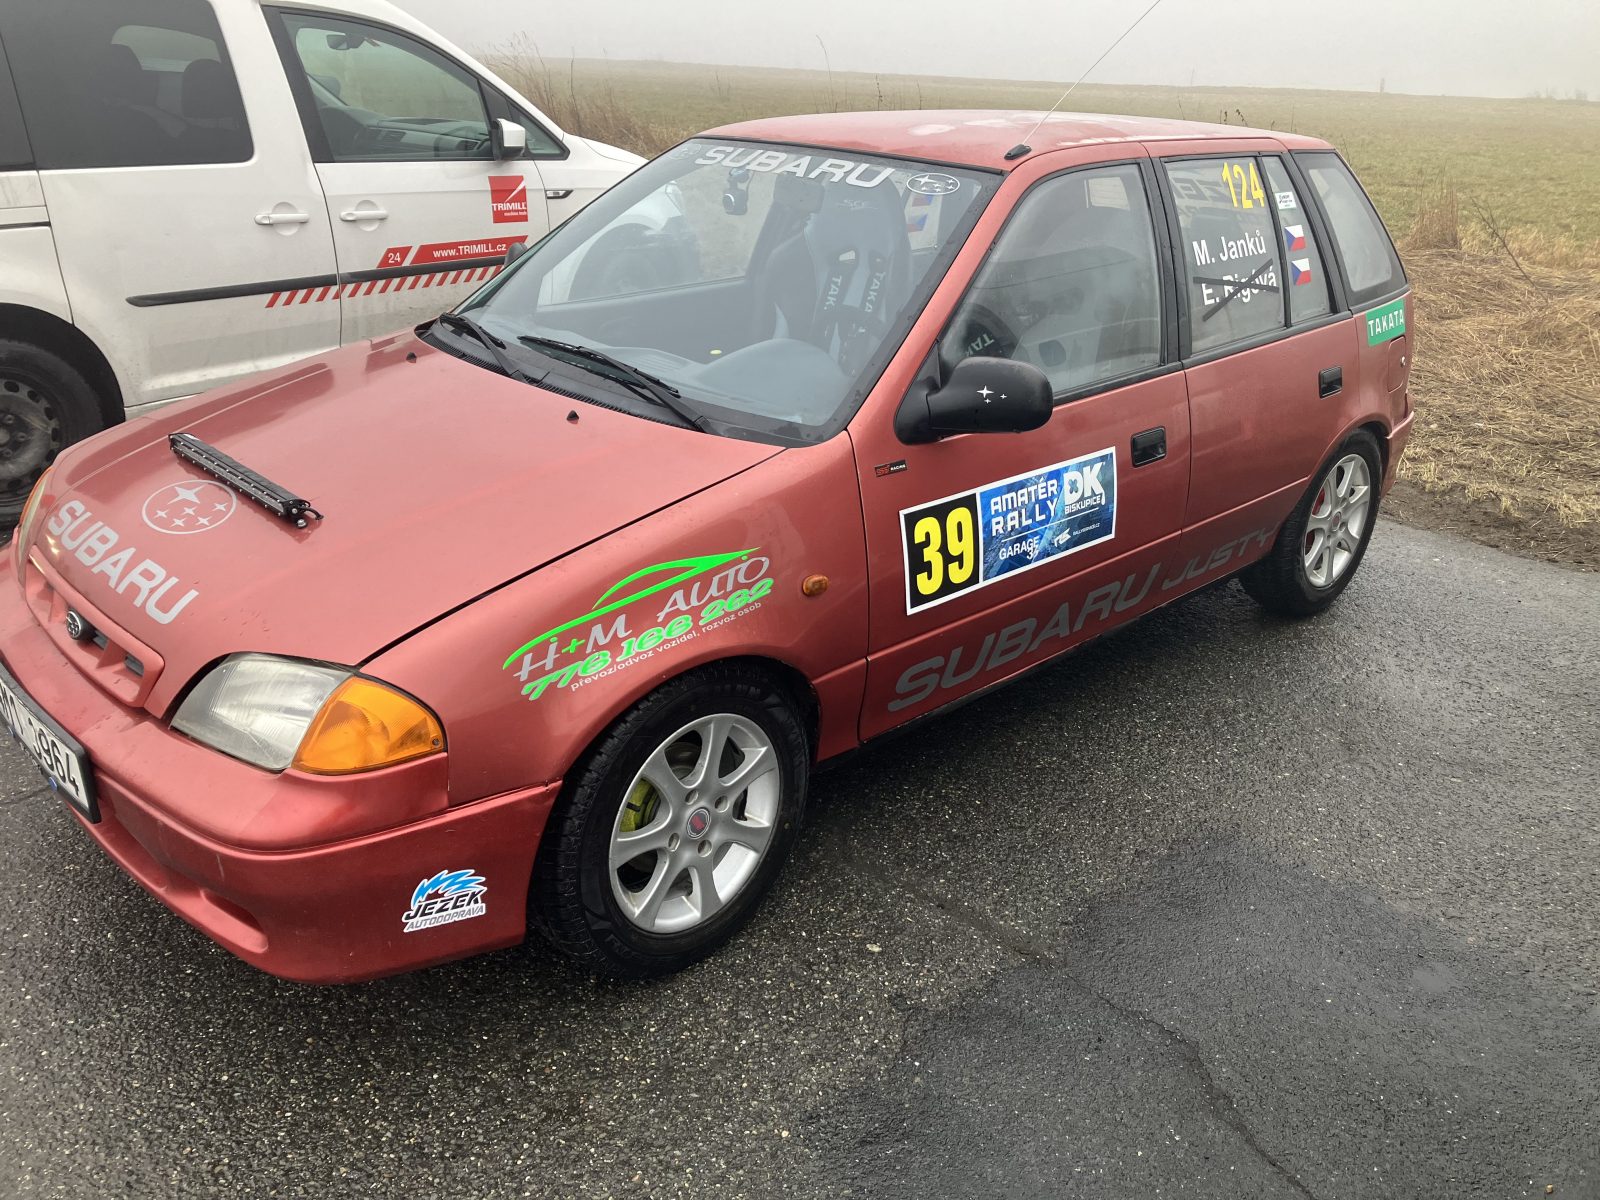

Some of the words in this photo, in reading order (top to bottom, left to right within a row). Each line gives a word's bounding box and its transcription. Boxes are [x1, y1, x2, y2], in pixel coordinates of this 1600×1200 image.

[694, 145, 896, 188] SUBARU
[1222, 162, 1266, 209] 124
[491, 202, 527, 211] TRIMILL
[387, 252, 401, 263] 24
[432, 243, 507, 258] www.TRIMILL.cz
[1192, 239, 1216, 266] M.
[1219, 229, 1267, 261] Janků
[824, 275, 842, 311] TAK
[1201, 281, 1220, 306] E.
[1368, 309, 1404, 337] TAKATA
[990, 476, 1058, 515] AMATÉR
[1064, 495, 1101, 515] BISKUPICE
[991, 498, 1058, 537] RALLY
[48, 500, 200, 625] SUBARU
[913, 507, 975, 596] 39
[999, 535, 1040, 560] GARAGE
[656, 556, 770, 622] AUTO
[888, 563, 1160, 713] SUBARU
[1161, 520, 1281, 591] JUSTY
[570, 650, 655, 691] převoz/odvoz
[701, 613, 737, 633] rozvoz
[738, 602, 762, 616] osob
[407, 905, 485, 930] AUTODOPRAVA
